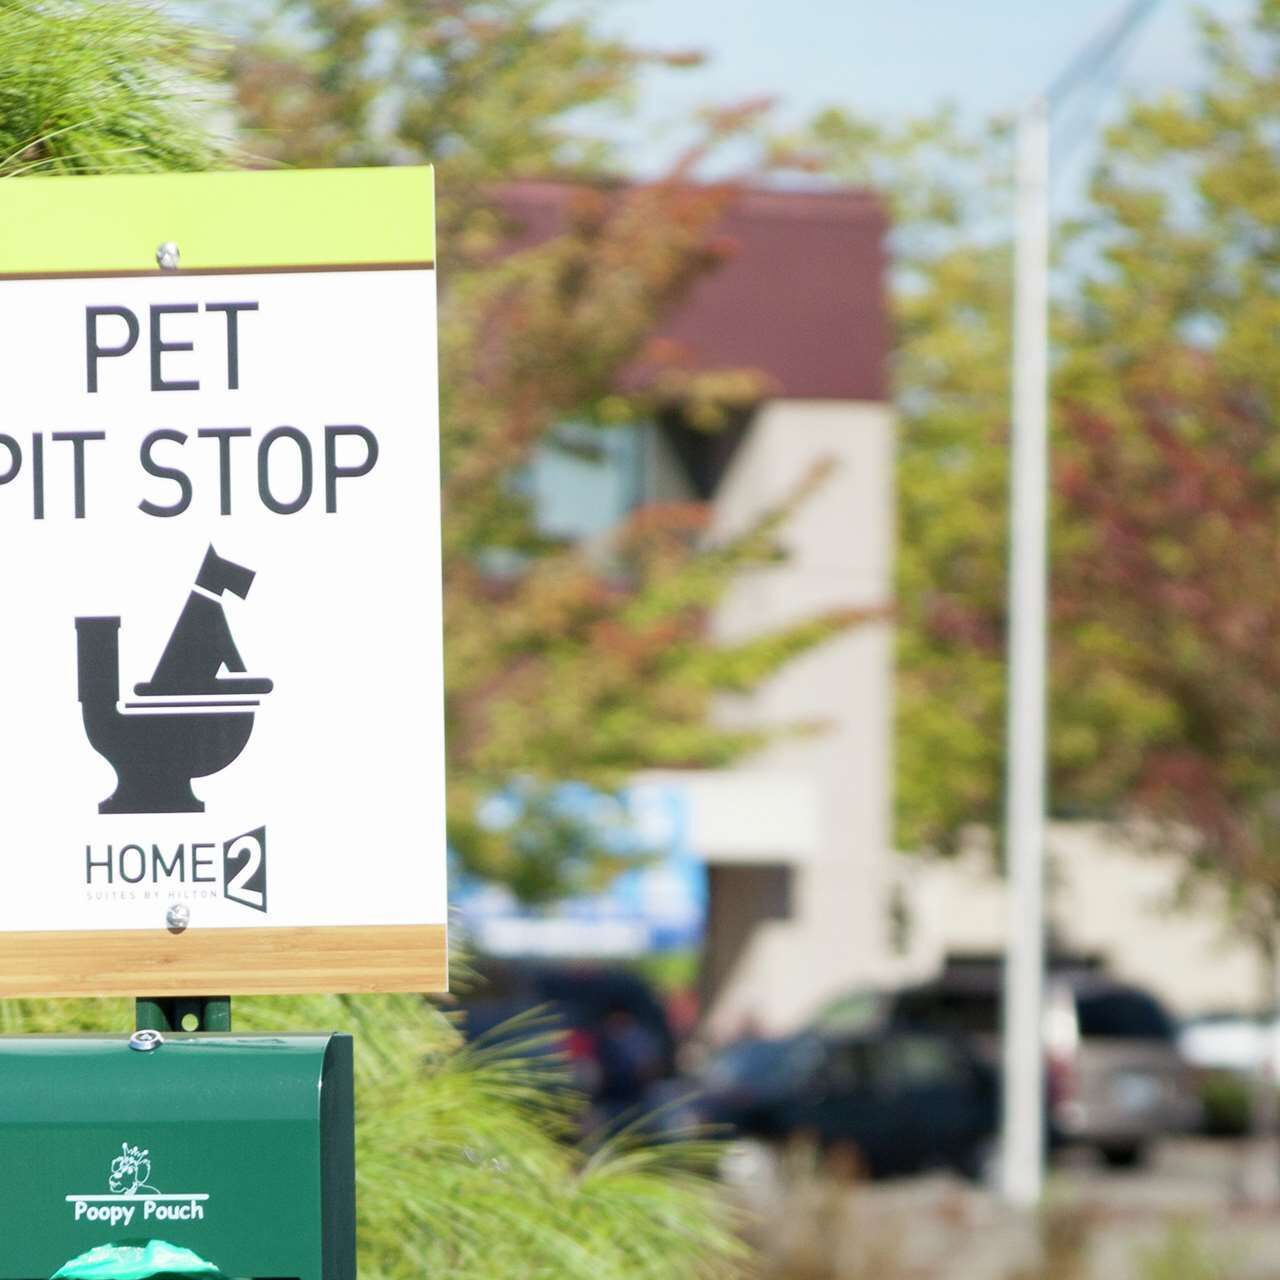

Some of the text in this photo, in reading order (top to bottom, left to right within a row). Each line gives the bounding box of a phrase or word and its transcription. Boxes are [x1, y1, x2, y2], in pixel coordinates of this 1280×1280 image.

[85, 301, 259, 394] PET
[138, 424, 379, 519] STOP
[86, 888, 217, 901] SUITES BY HILTON
[74, 1200, 204, 1226] Poopy Pouch
